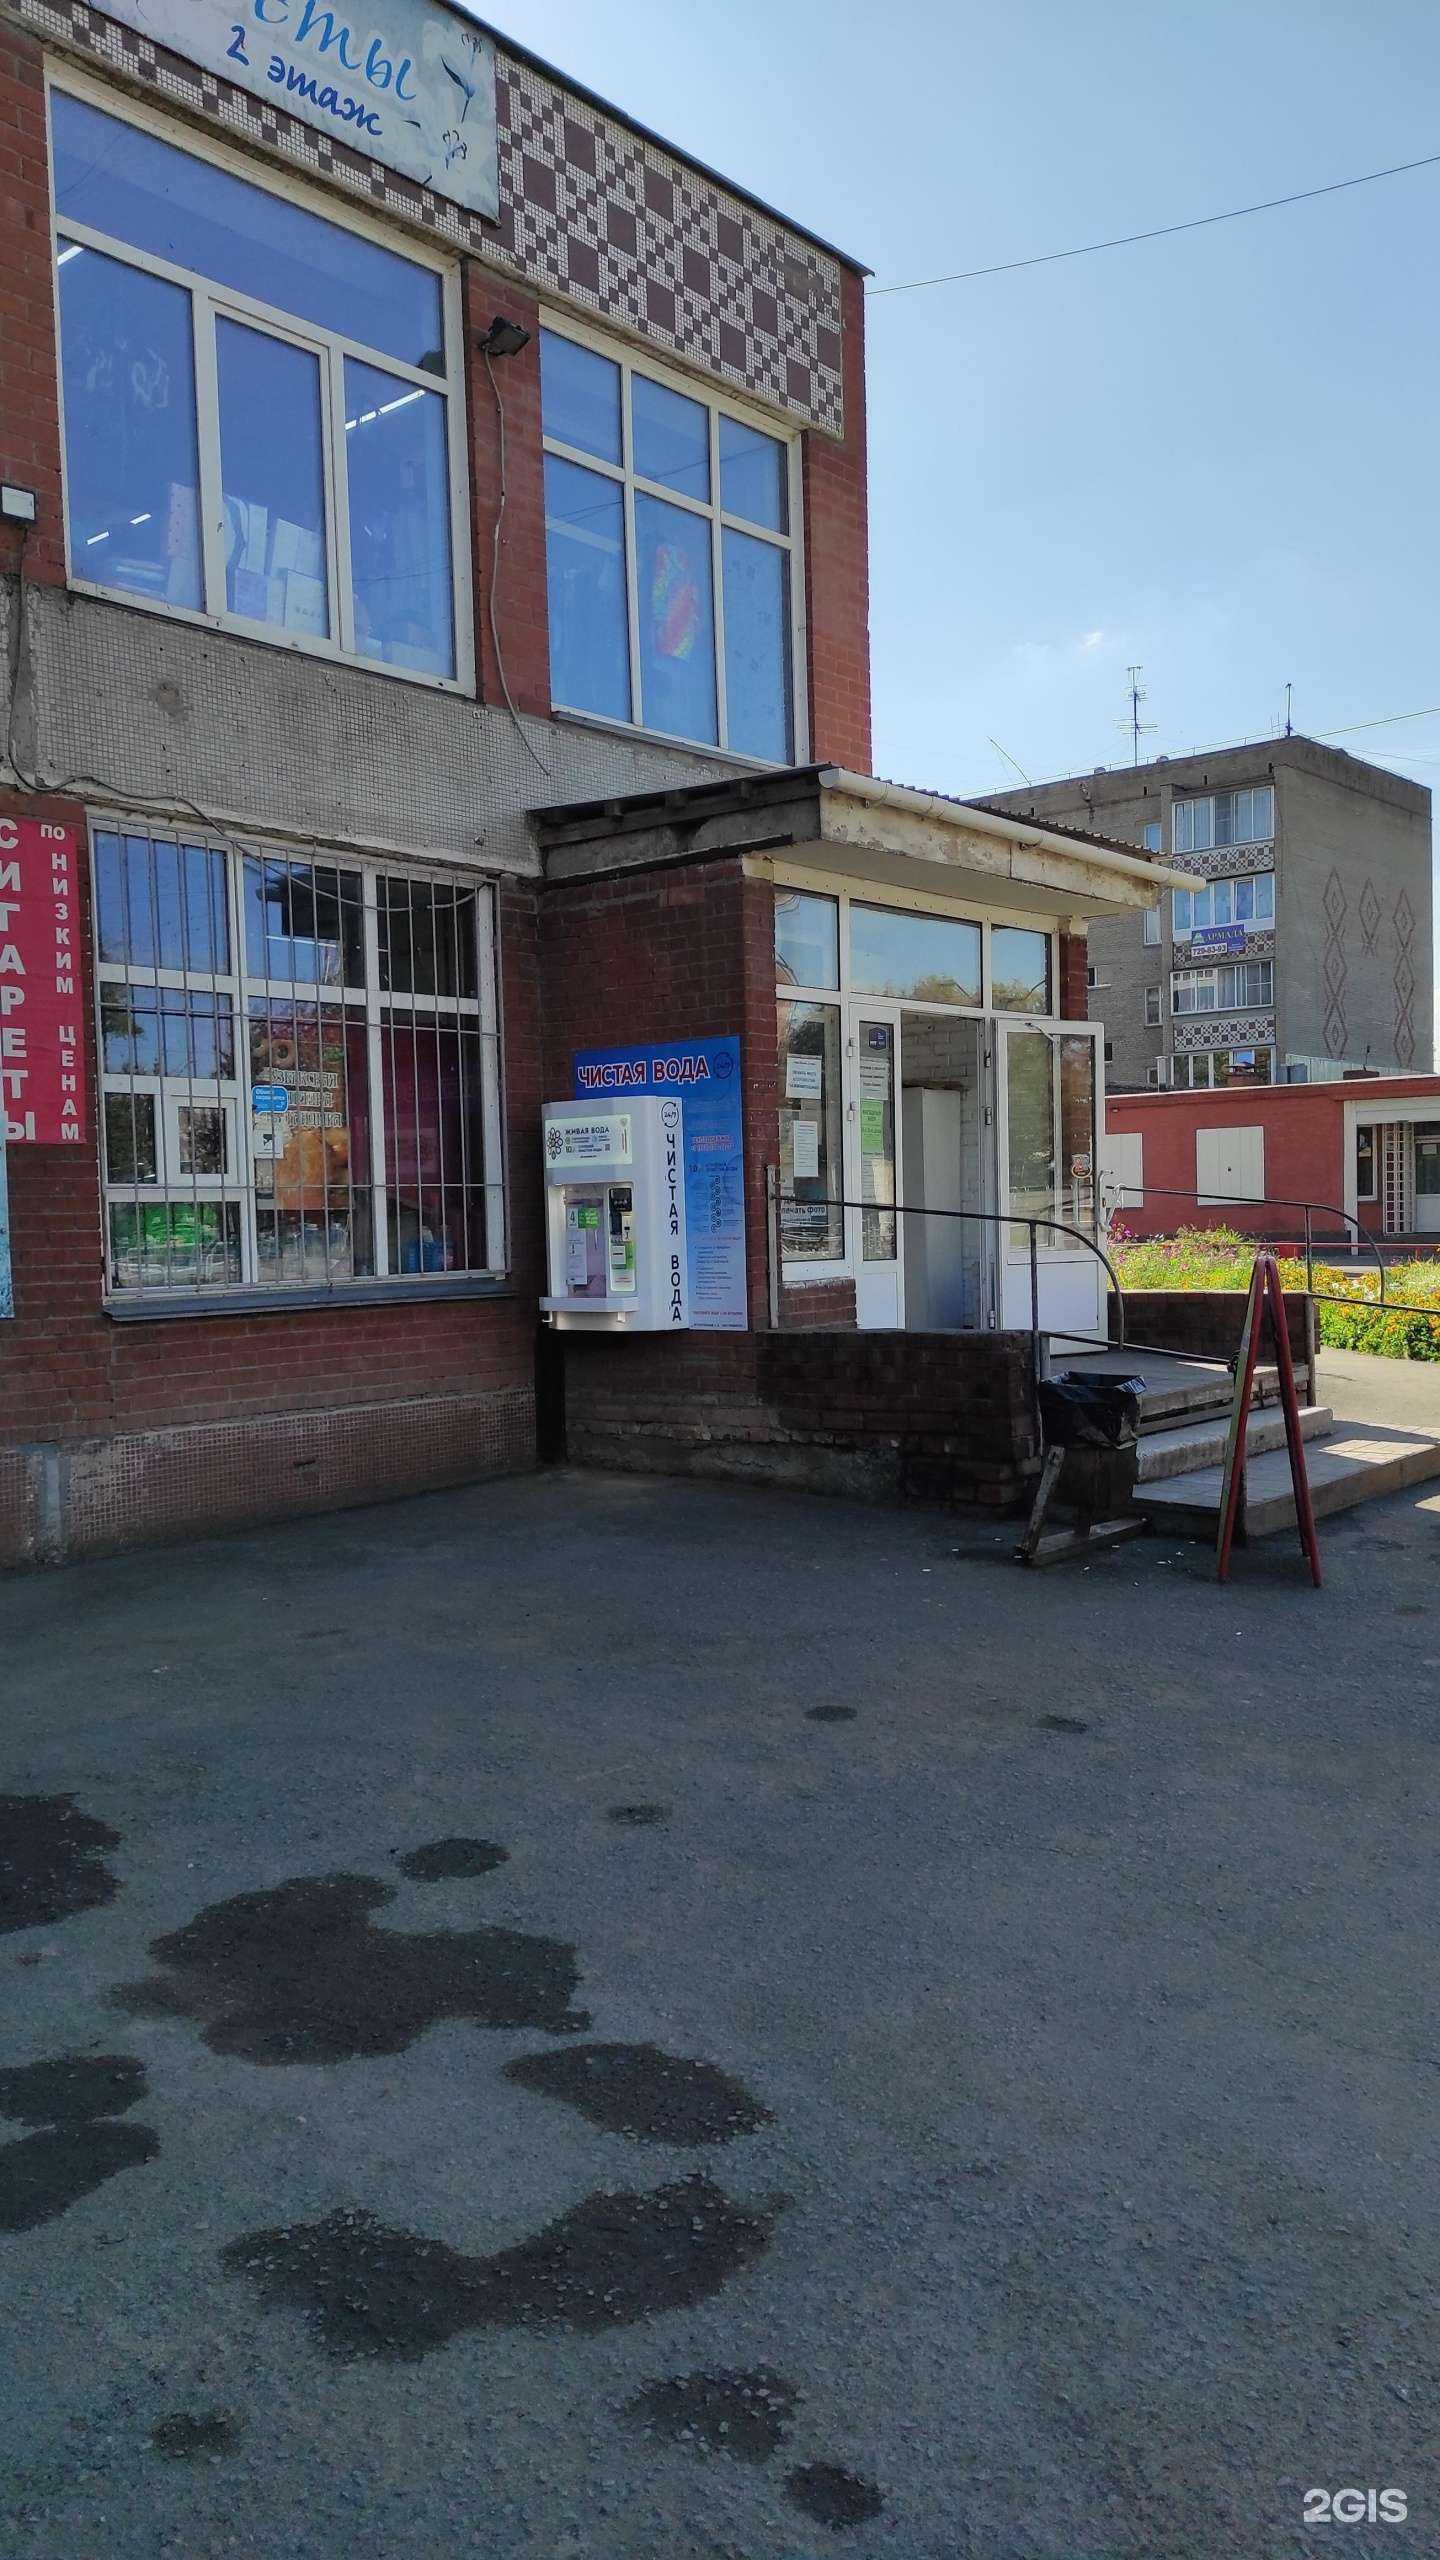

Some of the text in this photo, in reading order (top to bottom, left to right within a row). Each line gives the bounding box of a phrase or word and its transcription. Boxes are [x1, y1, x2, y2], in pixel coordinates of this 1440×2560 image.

[226, 25, 384, 137] 2 этаж
[51, 852, 75, 994] НИЗКИМ
[58, 1025, 80, 1141] ЦЕНАМ
[578, 1055, 711, 1089] ЧИСТАЯ ВОДА
[565, 1126, 610, 1135] ЖИВАЯ ВОДА
[666, 1133, 683, 1322] ЧИСТАЯ ВОДА
